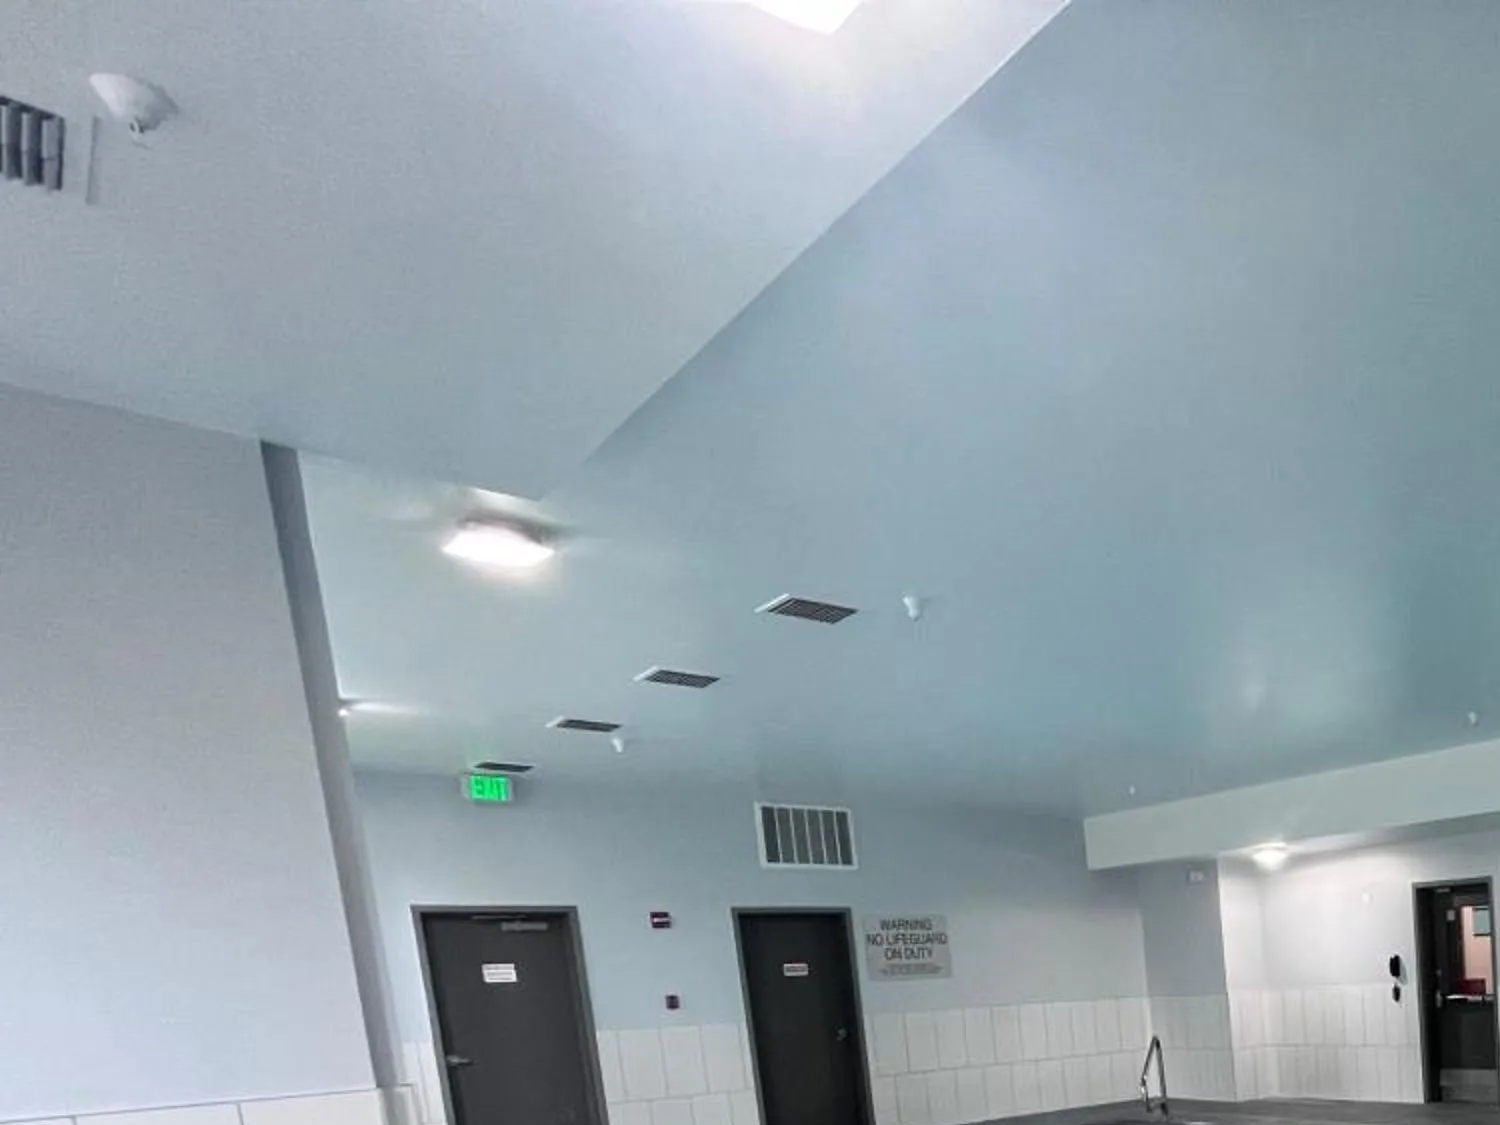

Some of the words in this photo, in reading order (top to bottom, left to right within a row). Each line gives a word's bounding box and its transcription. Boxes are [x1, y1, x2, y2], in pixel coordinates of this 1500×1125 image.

[472, 776, 508, 800] EXIT
[879, 918, 933, 931] WARNING
[865, 932, 884, 946] NO
[886, 932, 948, 945] LIFEGUARD
[884, 947, 902, 960] ON
[904, 946, 933, 960] DUTY
